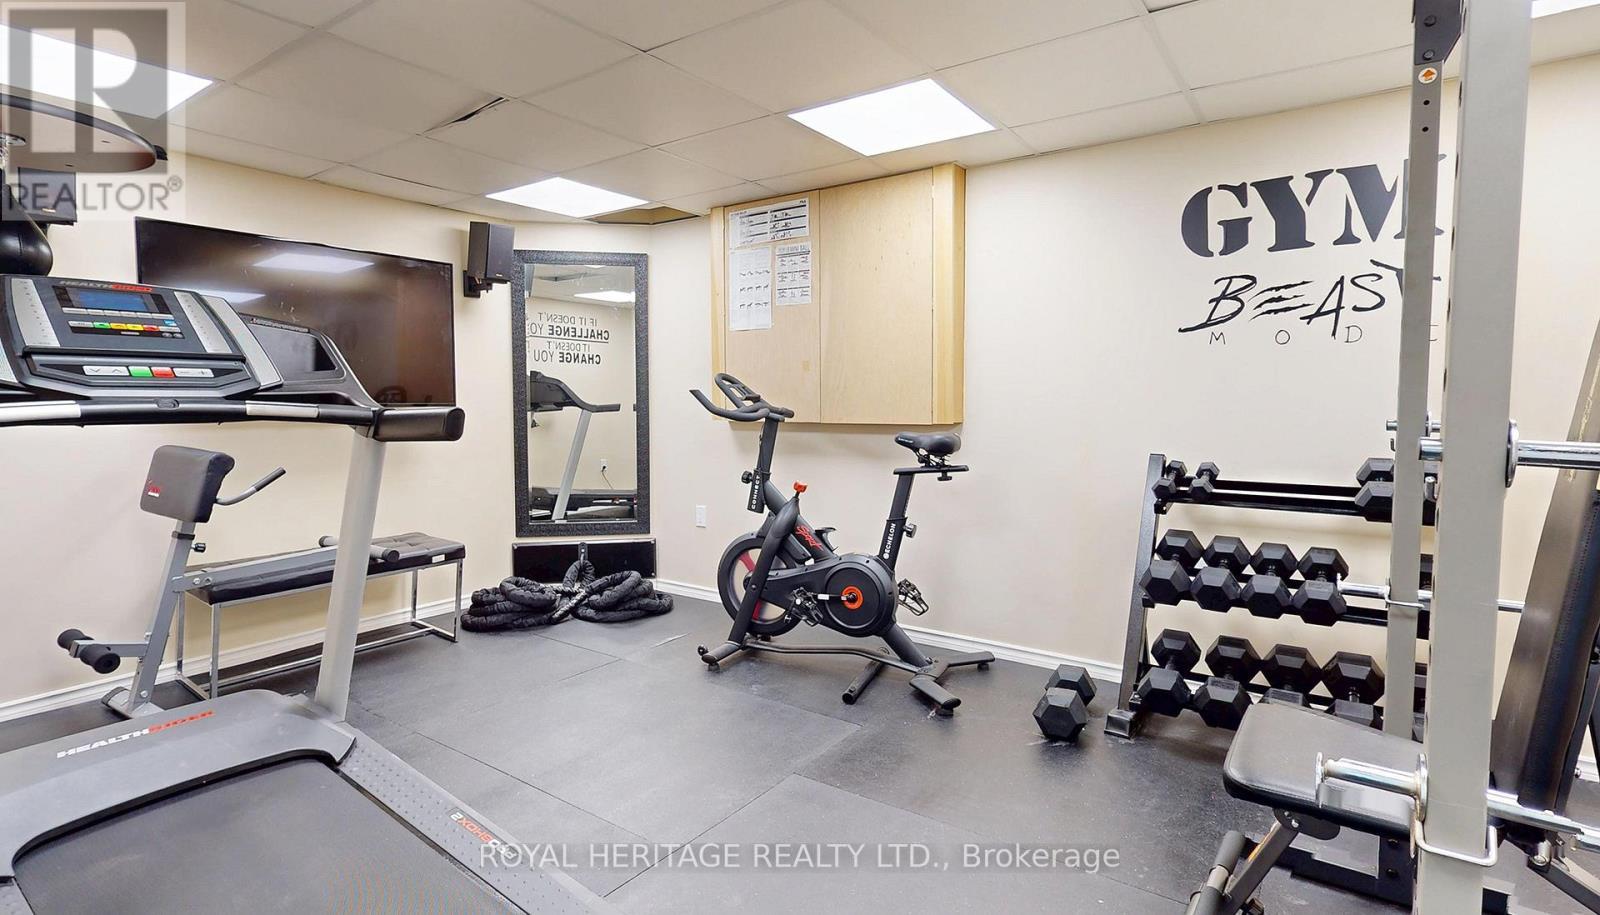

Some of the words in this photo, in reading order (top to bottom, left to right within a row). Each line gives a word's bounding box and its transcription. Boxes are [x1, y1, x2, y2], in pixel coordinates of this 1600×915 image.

[1181, 154, 1447, 257] GYM
[751, 474, 761, 510] CONNECT
[884, 522, 896, 554] ECHELON
